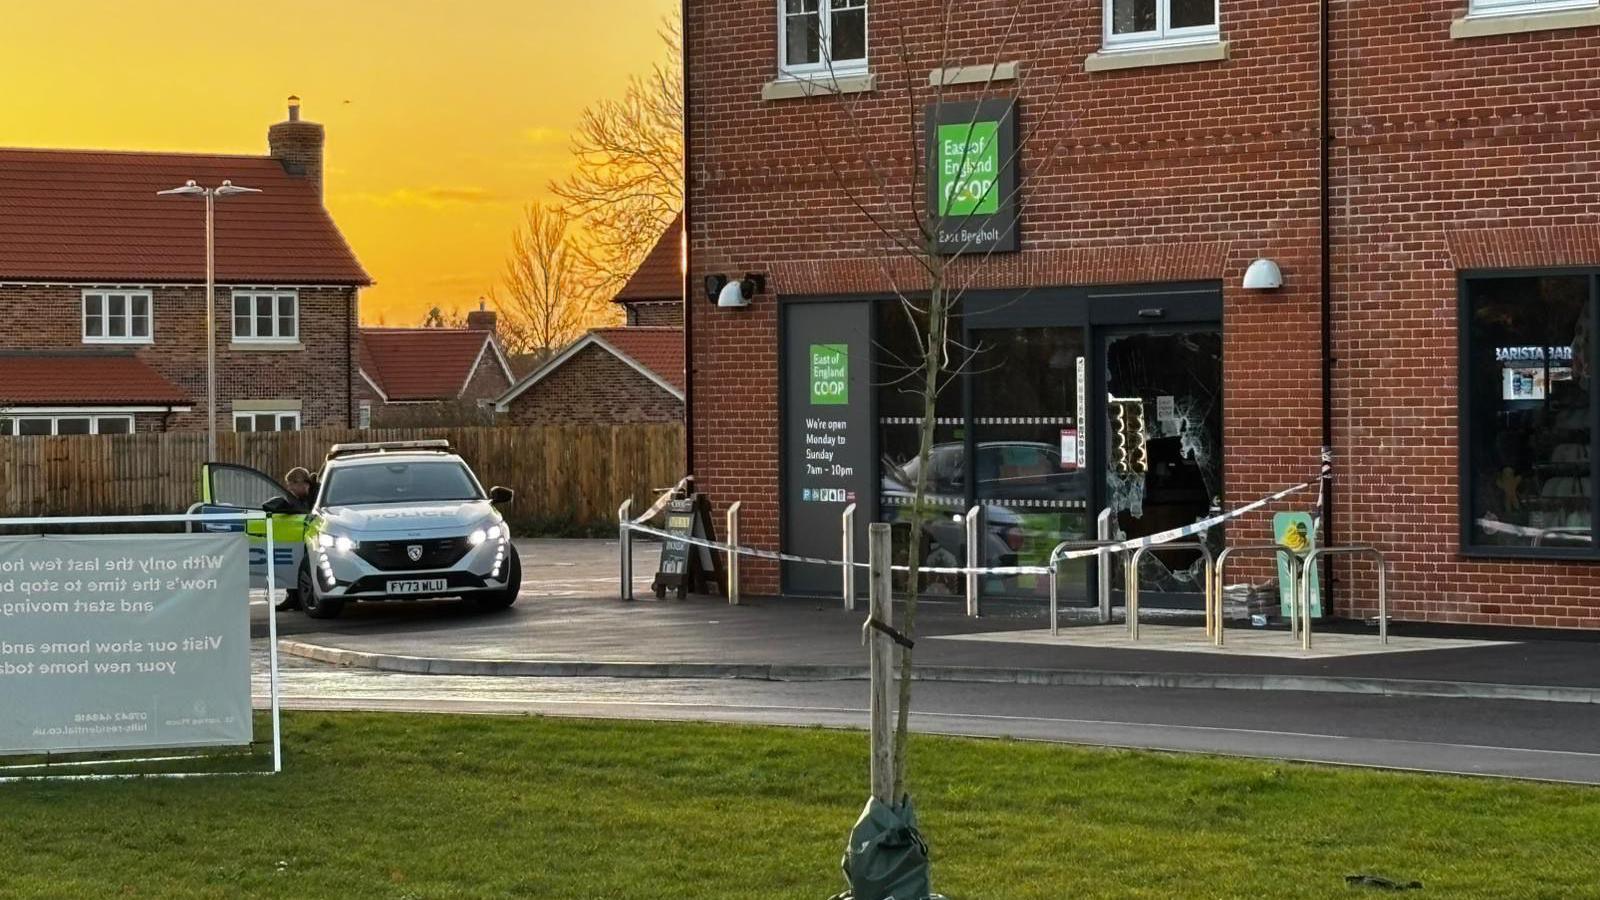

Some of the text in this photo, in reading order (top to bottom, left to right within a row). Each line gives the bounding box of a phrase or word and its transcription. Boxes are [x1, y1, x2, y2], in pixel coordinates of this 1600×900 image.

[944, 156, 992, 178] England
[961, 228, 999, 244] Bergholt
[813, 353, 840, 365] East of
[1495, 346, 1545, 361] BARISTA
[813, 366, 845, 379] England
[814, 381, 845, 395] COOP
[806, 418, 847, 432] We're open
[806, 434, 845, 446] Monday to
[806, 449, 834, 462] Sunday
[806, 464, 822, 475] 7am
[831, 464, 853, 477] 10pm
[368, 510, 456, 521] POLICE
[390, 580, 444, 593] FY73 WLU
